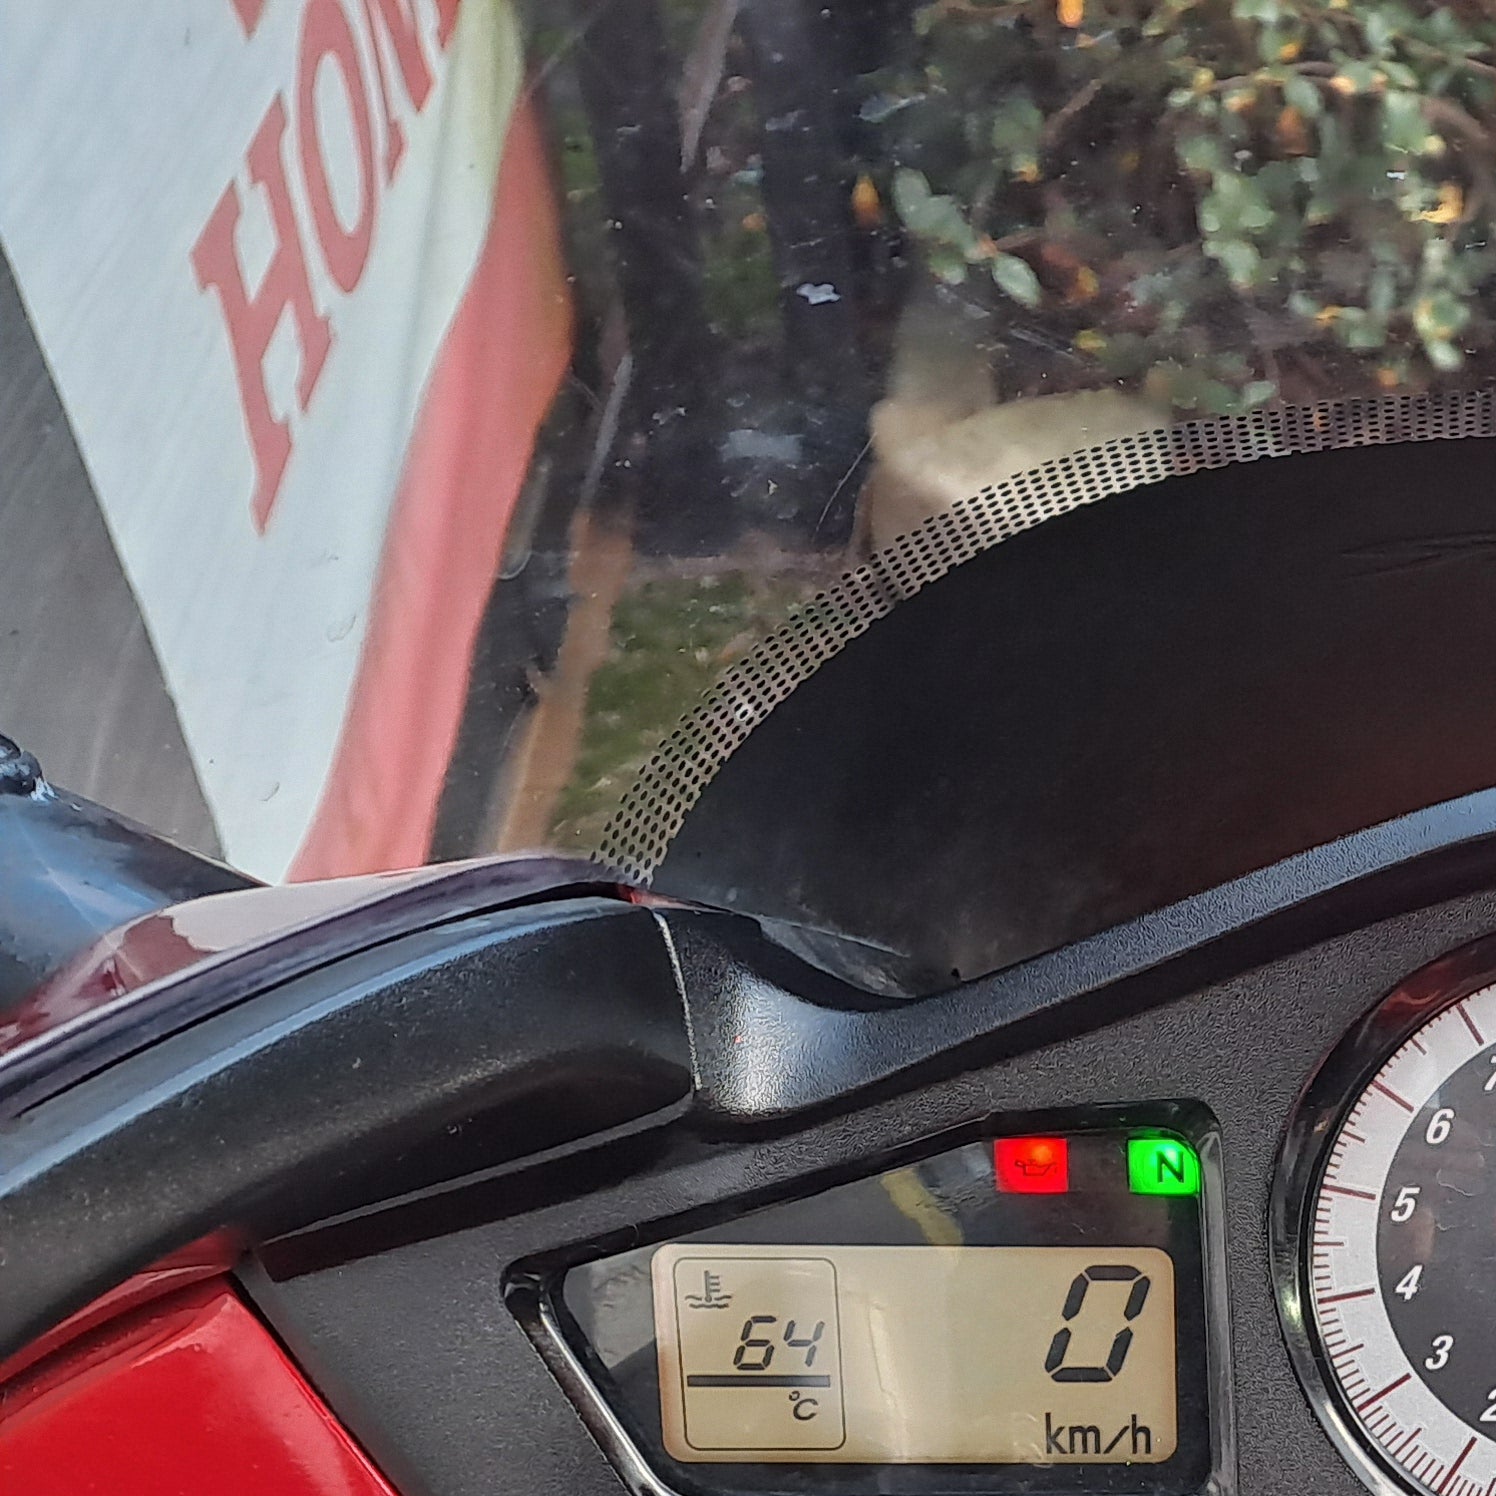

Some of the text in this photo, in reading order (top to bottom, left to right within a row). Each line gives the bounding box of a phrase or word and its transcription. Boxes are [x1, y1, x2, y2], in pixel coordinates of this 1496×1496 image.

[1425, 1108, 1455, 1145] 6
[1156, 1152, 1185, 1183] N
[1391, 1187, 1420, 1222] 5
[1394, 1265, 1423, 1301] 4
[1044, 1264, 1151, 1383] 0
[732, 1315, 825, 1371] 64
[1425, 1335, 1454, 1371] 3
[1044, 1412, 1152, 1455] km/h
